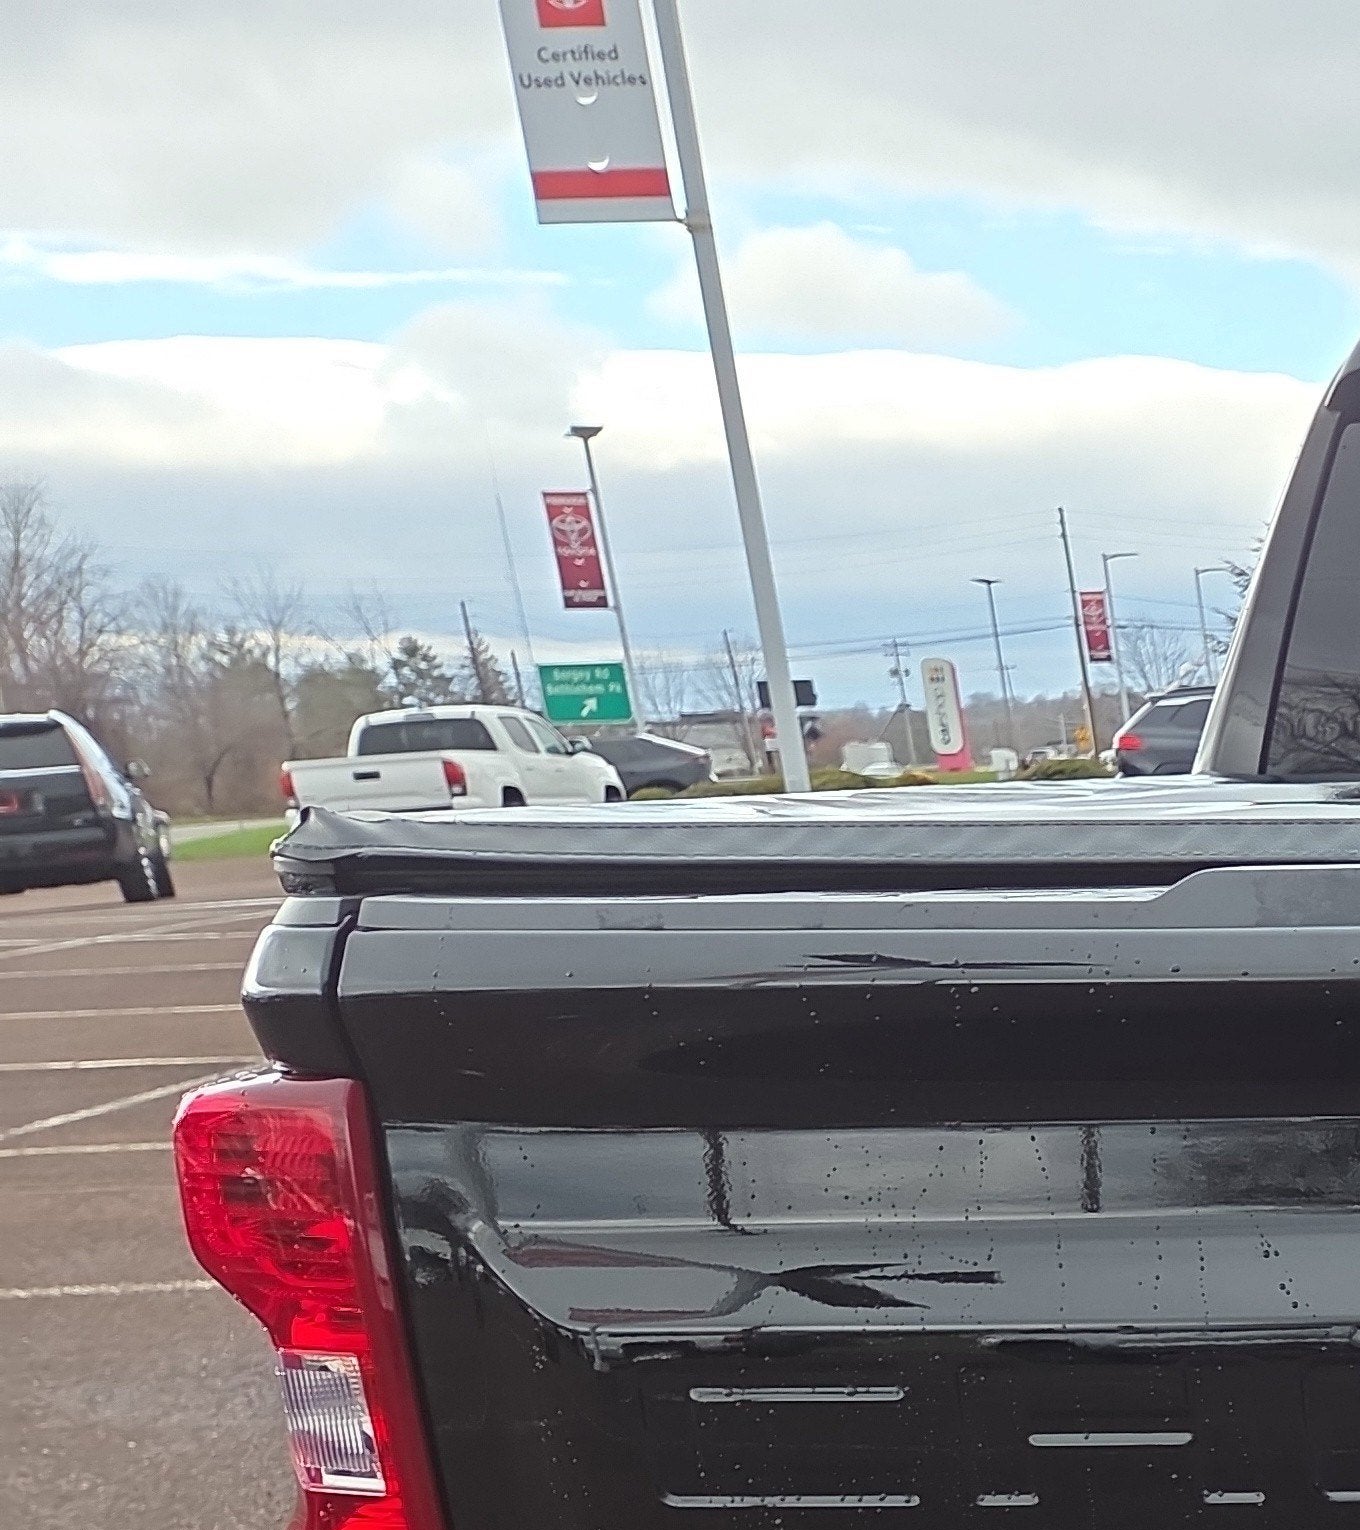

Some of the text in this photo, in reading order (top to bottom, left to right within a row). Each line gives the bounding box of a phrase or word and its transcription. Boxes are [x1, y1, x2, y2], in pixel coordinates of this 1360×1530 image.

[537, 43, 619, 63] Certified
[519, 68, 647, 89] Used Vehicles
